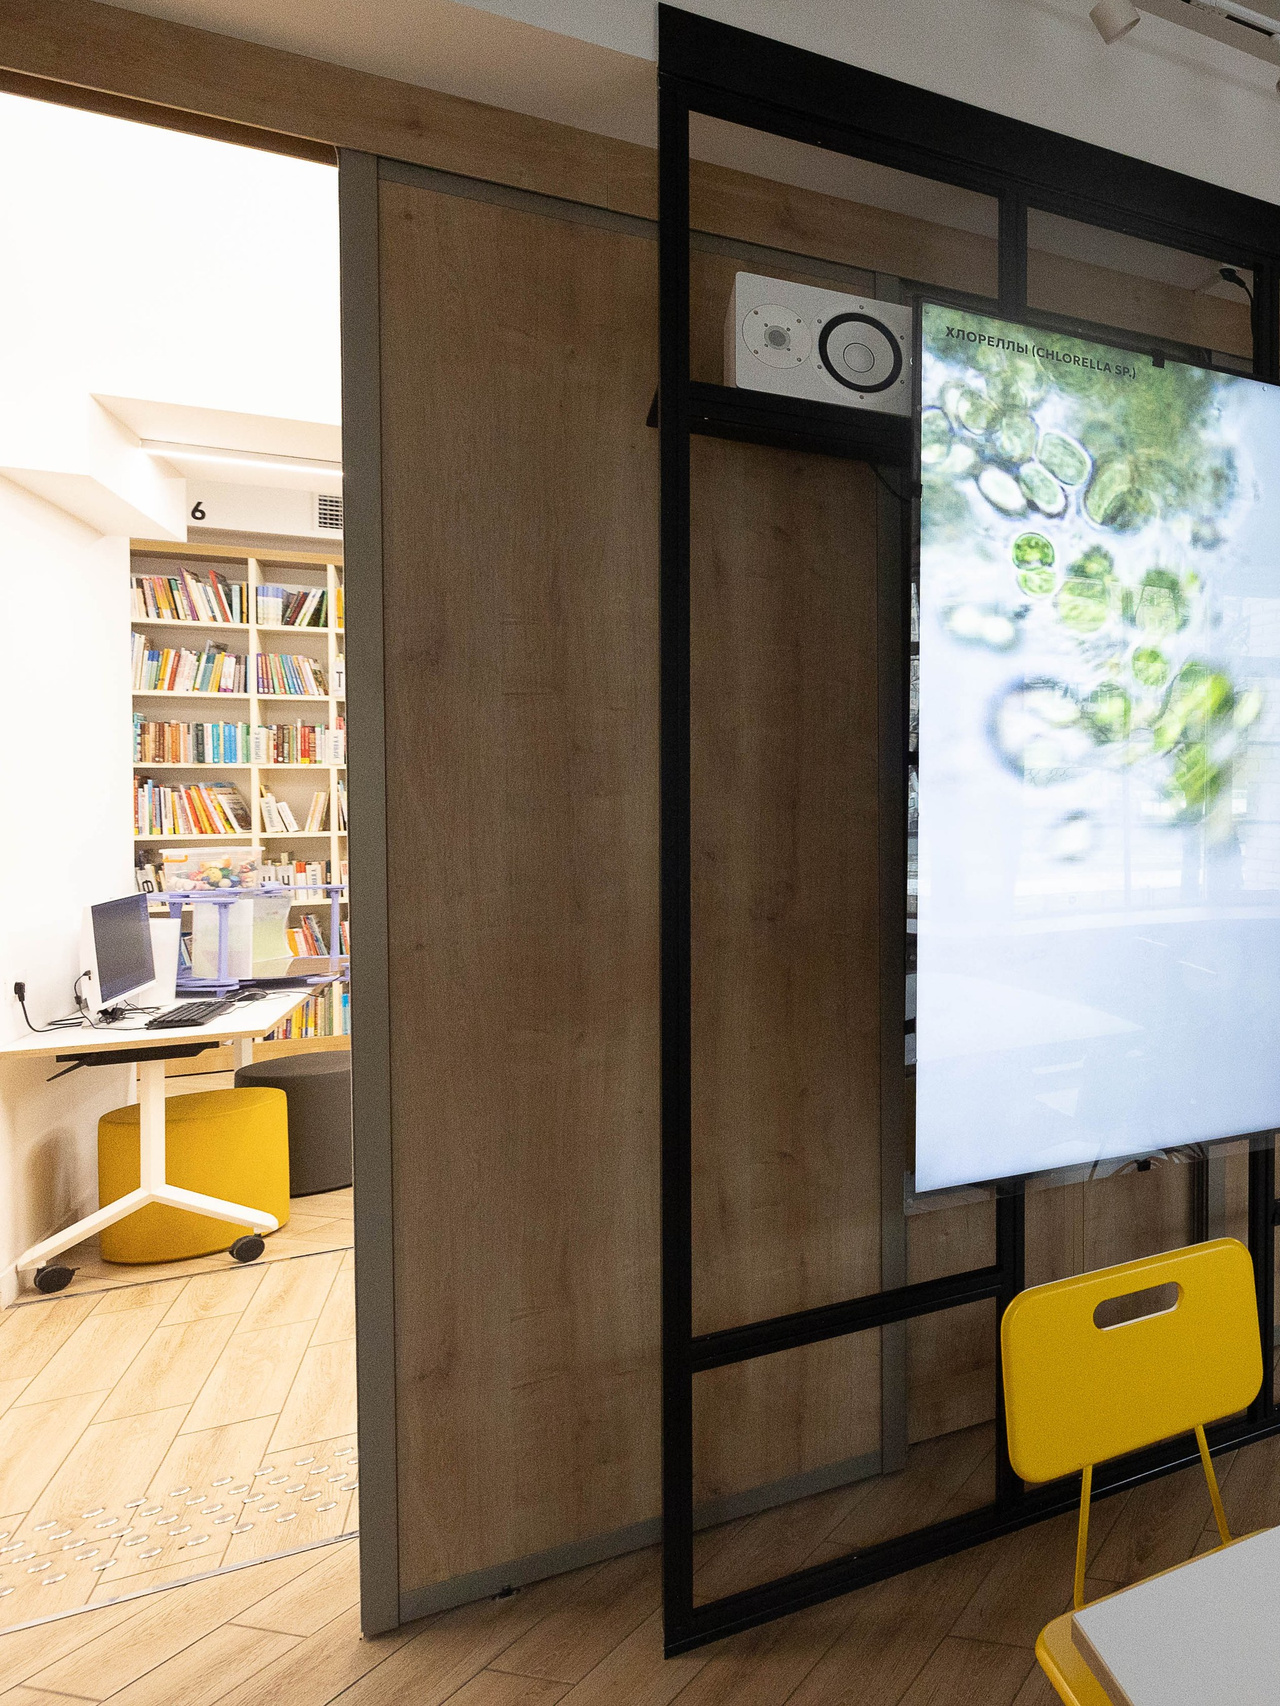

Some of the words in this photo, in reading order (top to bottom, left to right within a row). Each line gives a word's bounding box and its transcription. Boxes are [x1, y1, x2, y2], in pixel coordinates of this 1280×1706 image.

[945, 325, 1029, 354] ХЛОРЕЛЛЫ
[1031, 344, 1112, 374] (CHLORELLA
[1114, 363, 1137, 380] SP.)
[191, 501, 206, 520] 6
